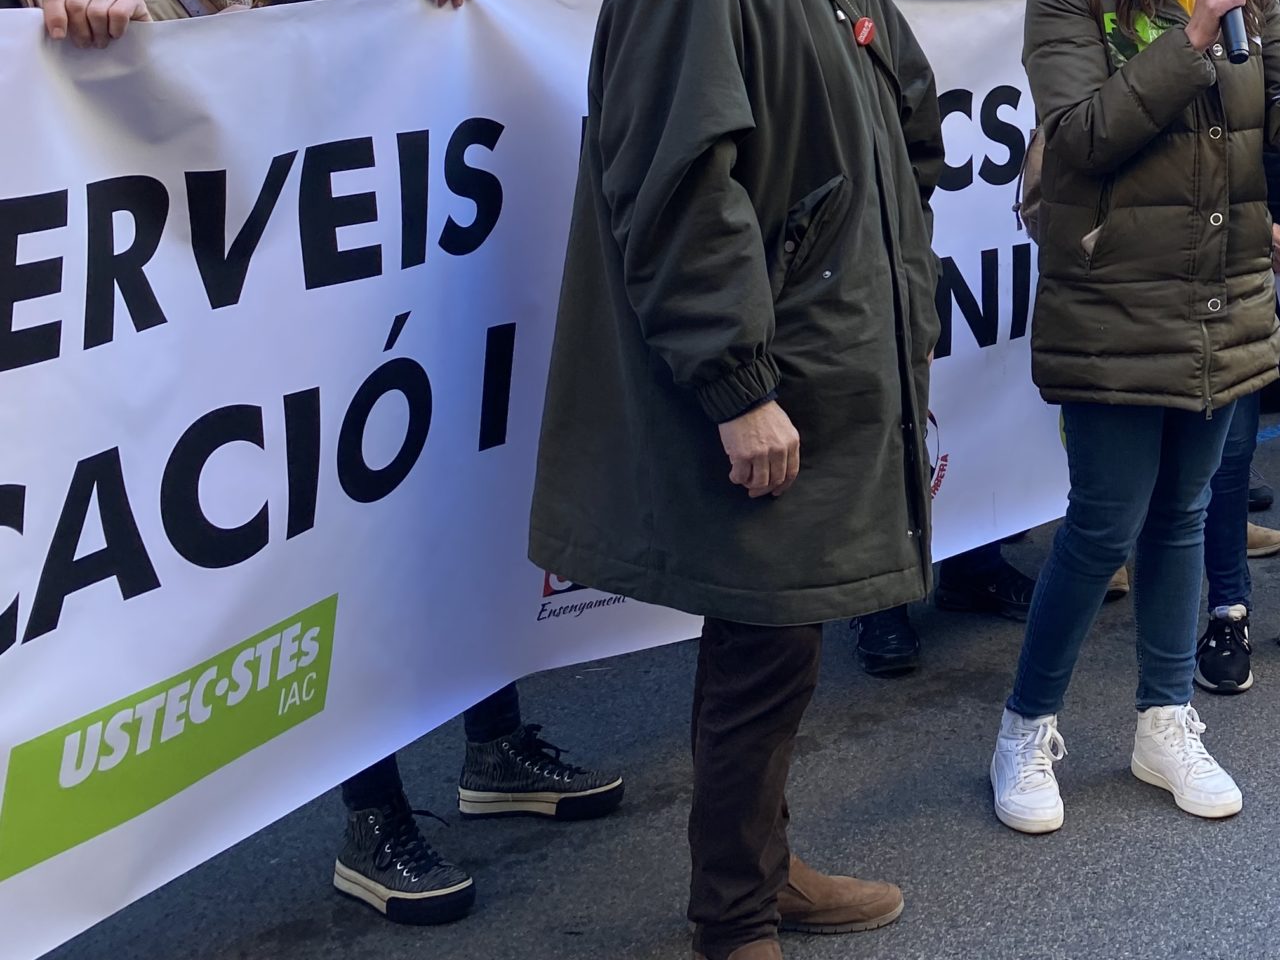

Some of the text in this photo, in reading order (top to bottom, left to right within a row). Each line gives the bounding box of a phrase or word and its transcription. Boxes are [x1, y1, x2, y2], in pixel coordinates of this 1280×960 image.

[0, 311, 433, 656] ACIÓ
[479, 322, 517, 452] I
[537, 595, 626, 621] Ensenyament
[278, 671, 317, 716] IAC
